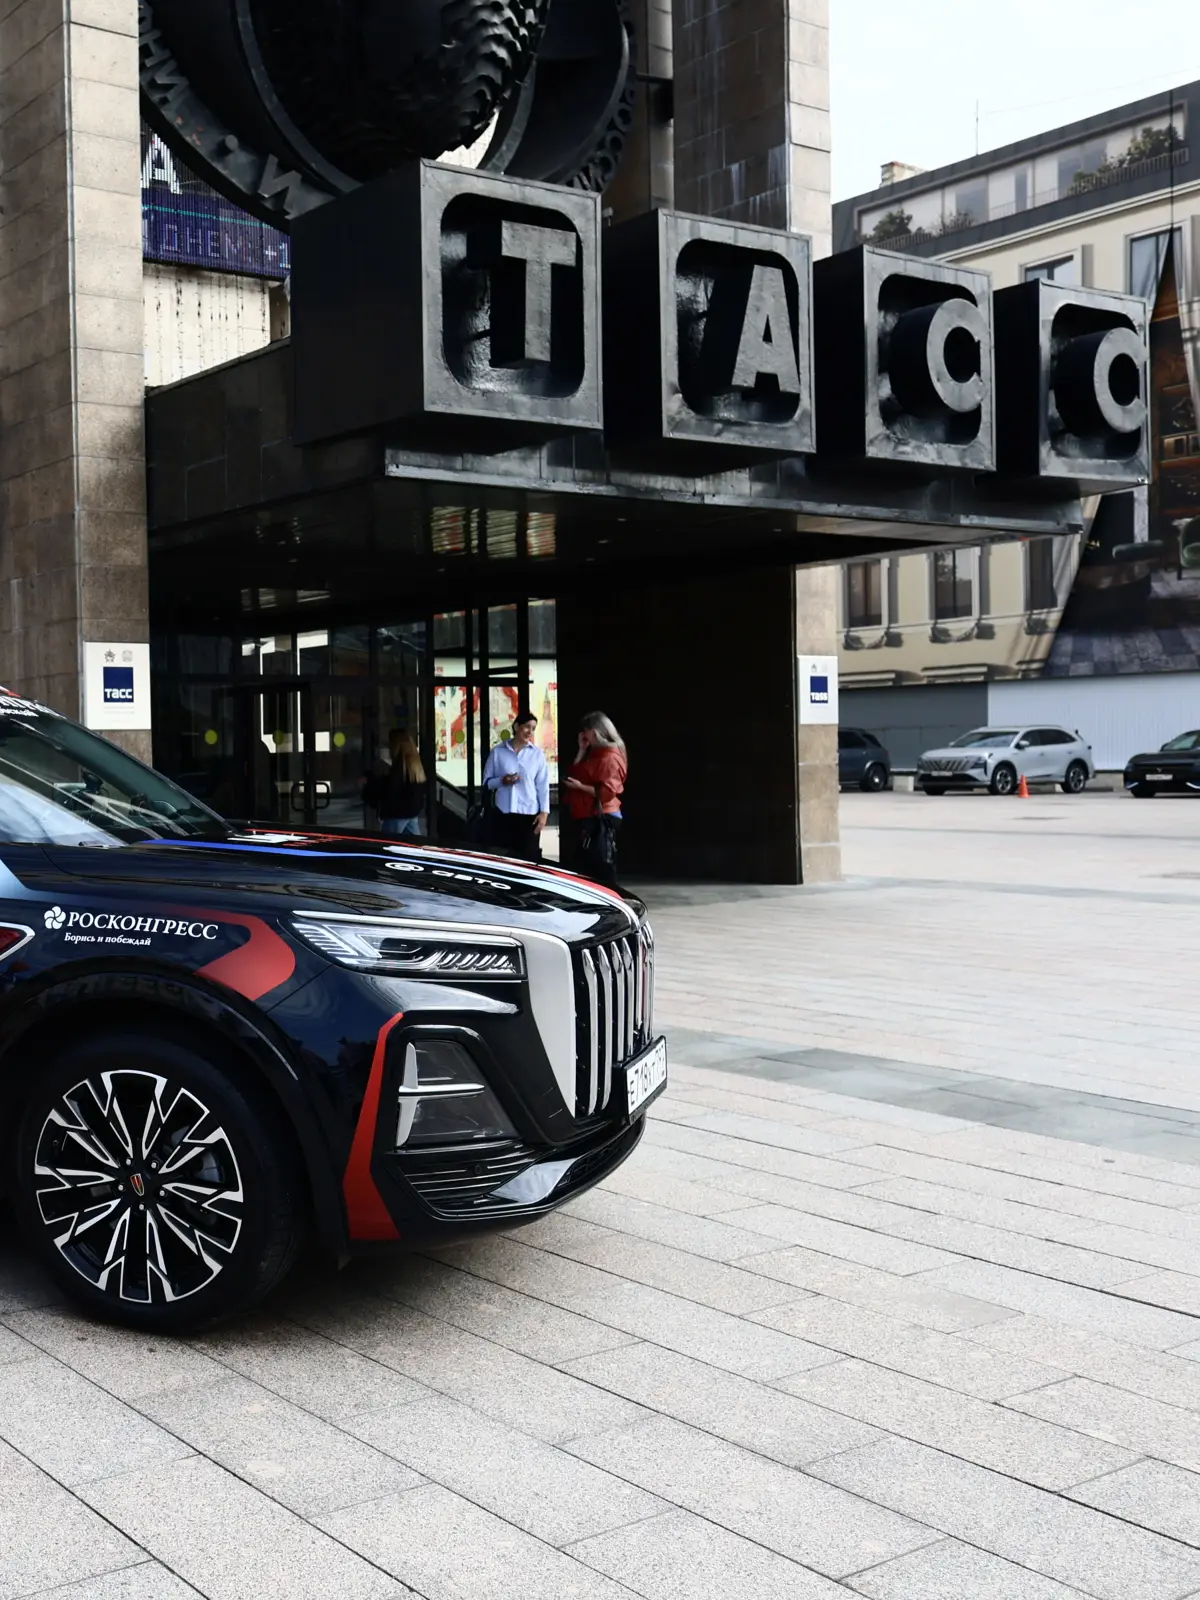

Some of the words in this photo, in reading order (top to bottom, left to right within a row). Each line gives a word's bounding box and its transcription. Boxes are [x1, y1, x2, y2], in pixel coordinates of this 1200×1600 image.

[500, 219, 1148, 434] ТАСС
[63, 932, 96, 944] Борись
[96, 935, 104, 943] и
[105, 934, 152, 947] побеждай
[67, 911, 218, 940] РОСКОНГРЕСС
